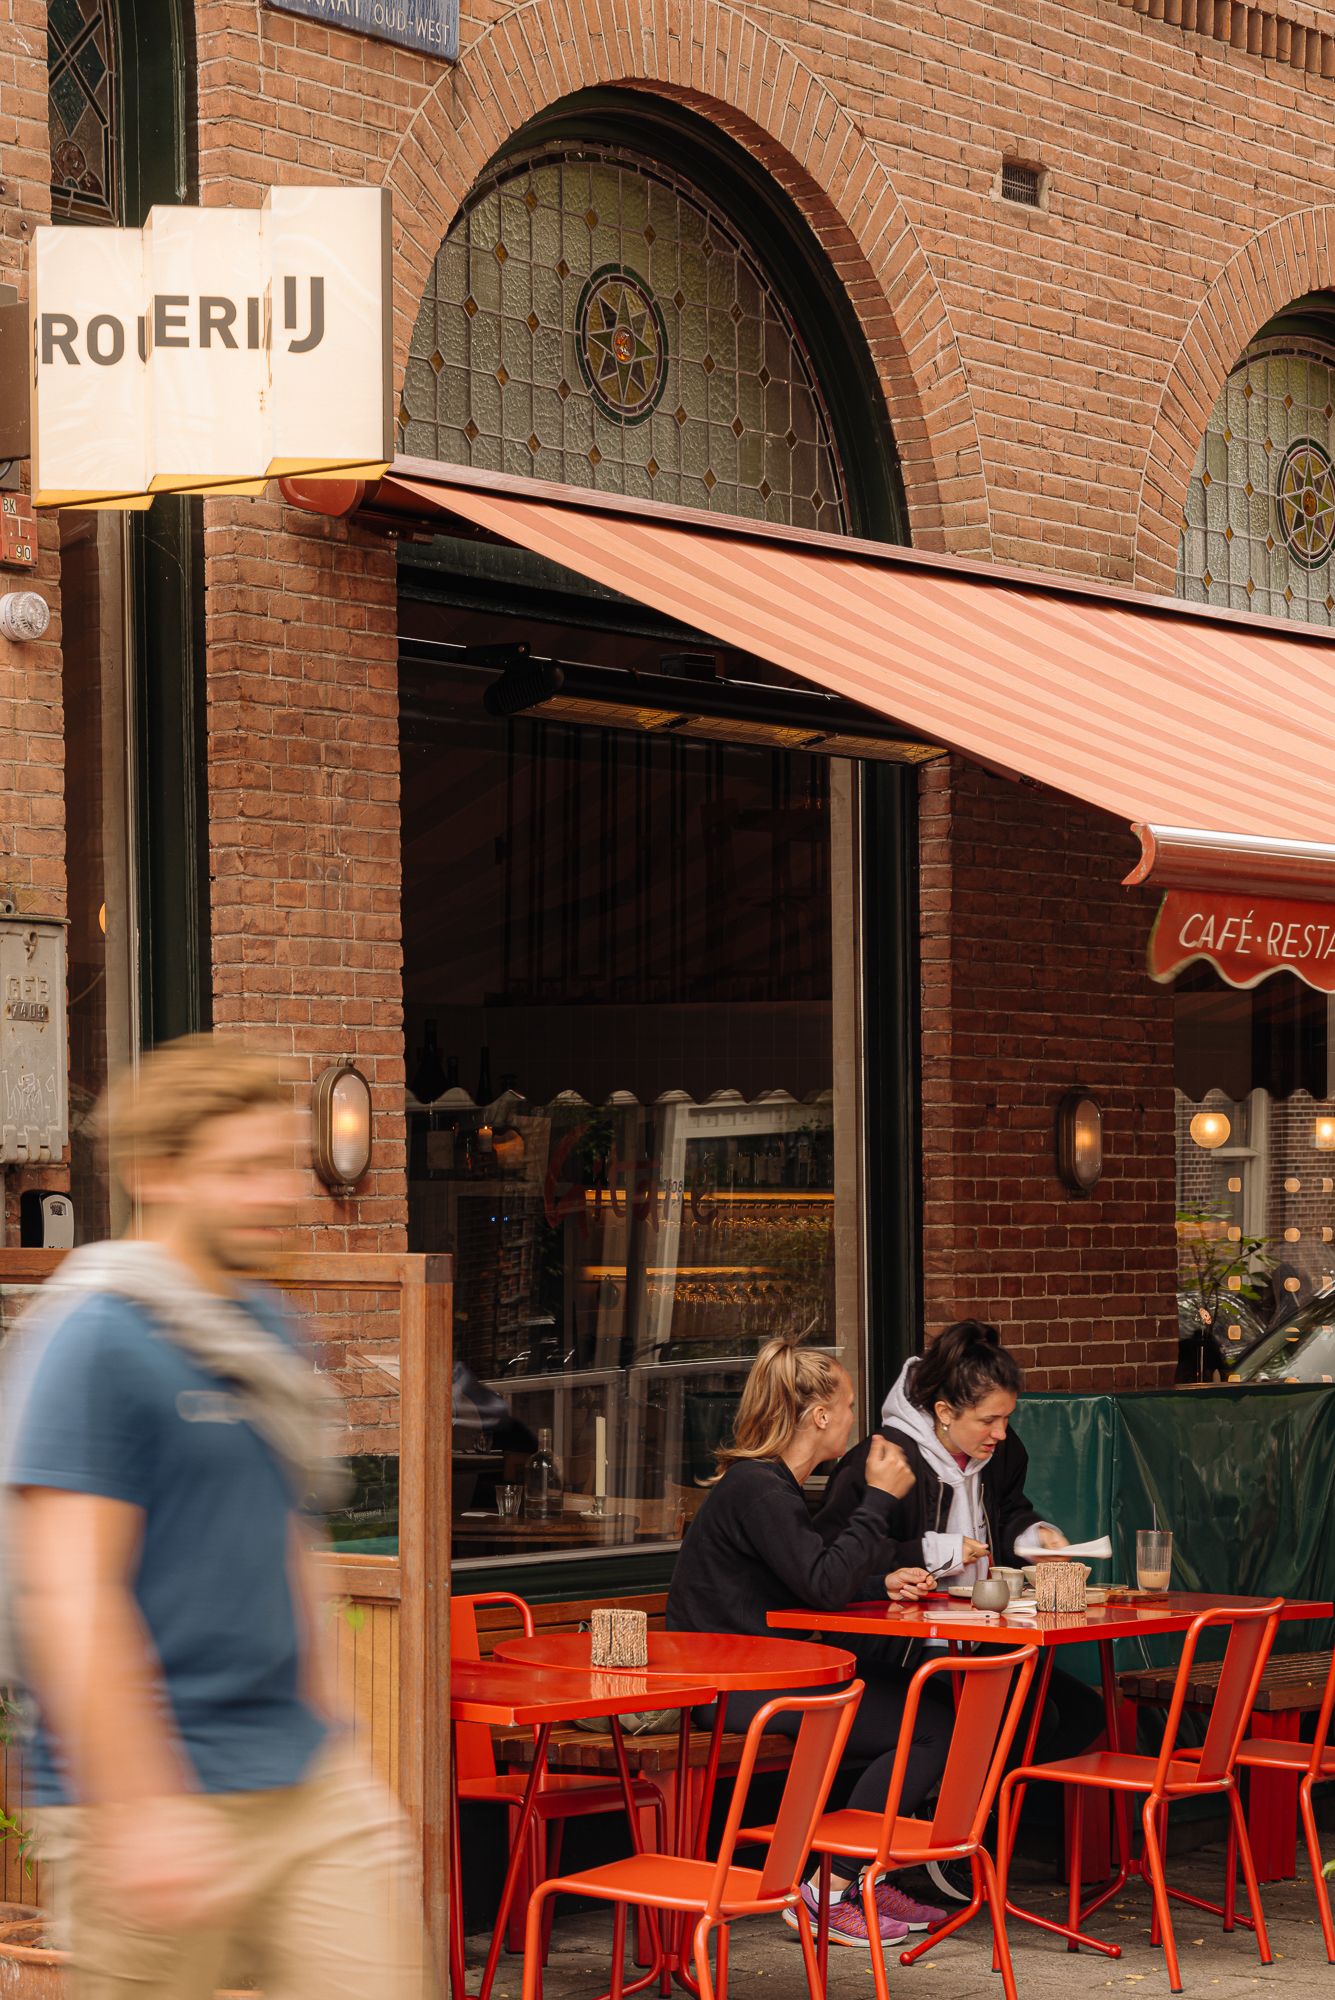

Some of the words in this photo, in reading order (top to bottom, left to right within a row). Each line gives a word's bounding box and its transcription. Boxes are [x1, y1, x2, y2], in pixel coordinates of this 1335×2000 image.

[374, 3, 450, 45] OUD-WEST
[3, 498, 16, 513] BK
[1178, 910, 1255, 954] CAFÉ
